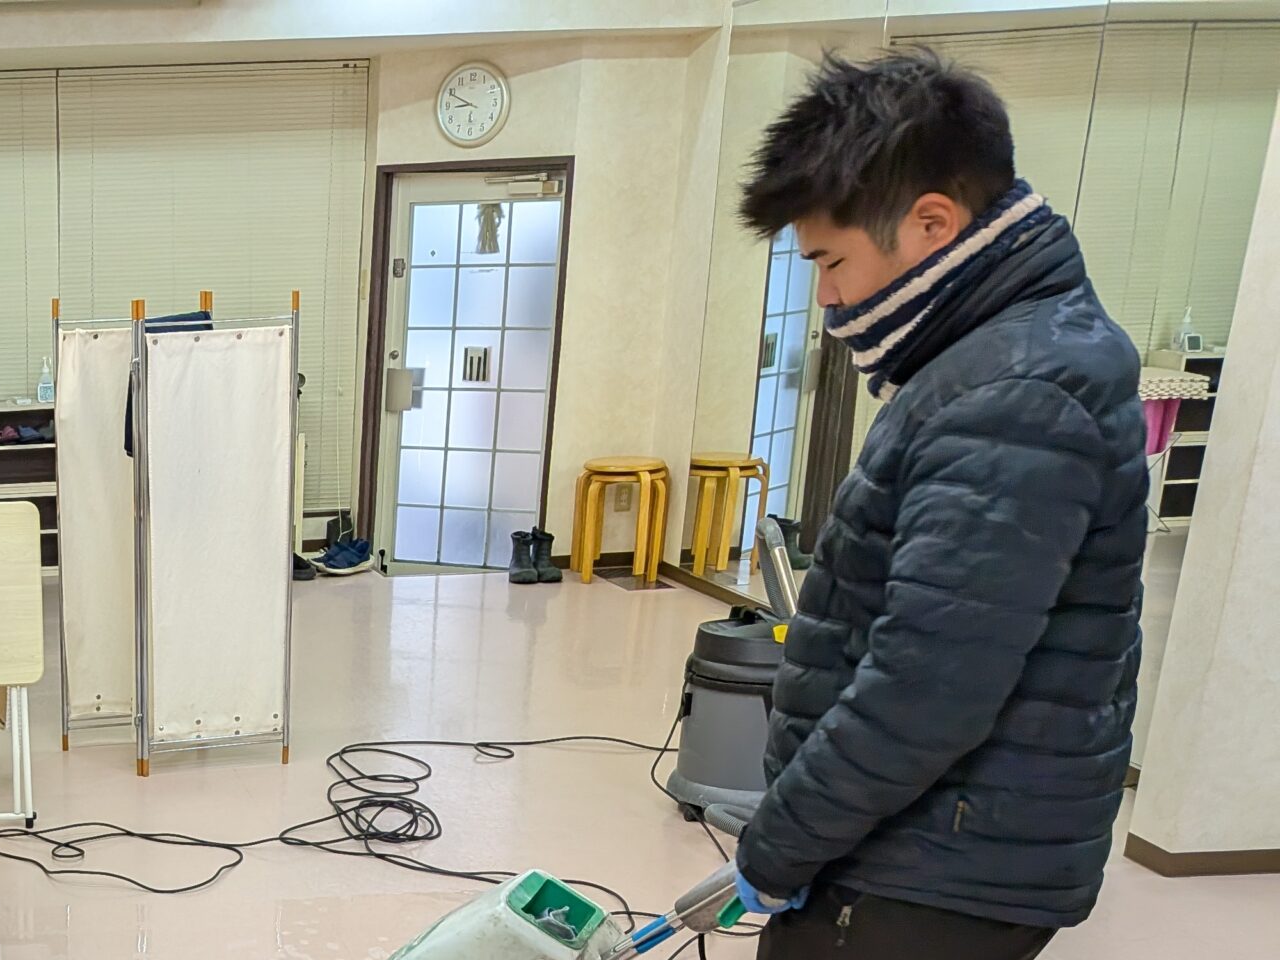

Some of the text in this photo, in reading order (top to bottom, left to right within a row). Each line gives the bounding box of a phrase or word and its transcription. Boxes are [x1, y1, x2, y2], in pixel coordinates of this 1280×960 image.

[458, 77, 464, 86] 11
[470, 72, 477, 82] 12
[482, 75, 486, 84] 1
[445, 101, 451, 111] 9
[492, 98, 497, 107] 3
[448, 115, 453, 124] 8
[488, 112, 494, 121] 4
[456, 125, 461, 134] 7
[467, 127, 473, 136] 6
[479, 123, 485, 132] 5
